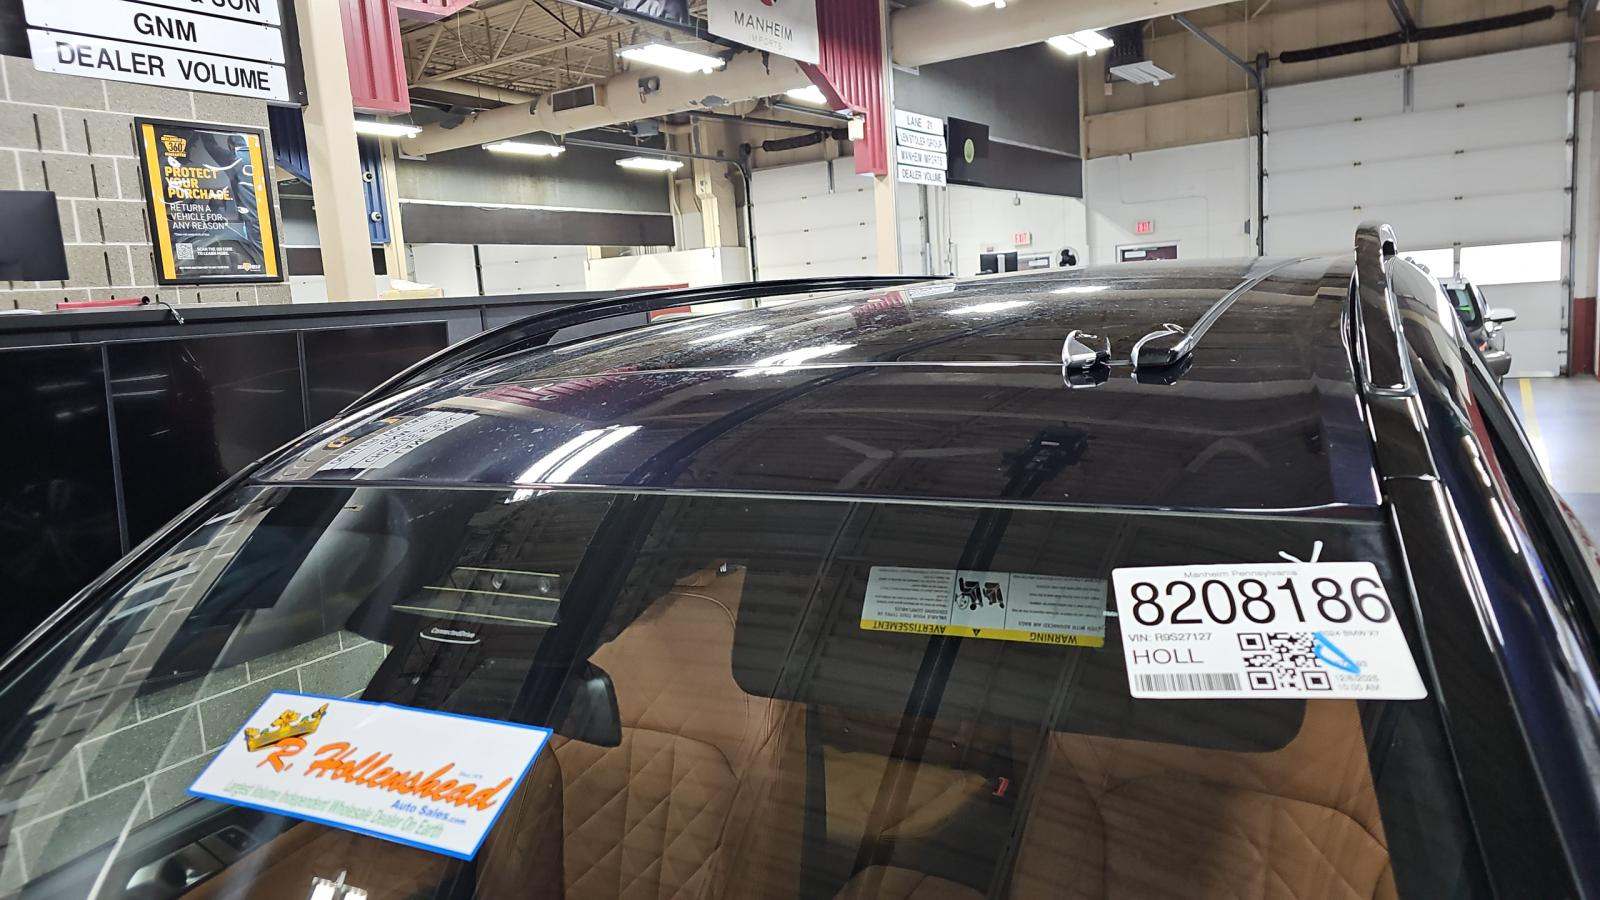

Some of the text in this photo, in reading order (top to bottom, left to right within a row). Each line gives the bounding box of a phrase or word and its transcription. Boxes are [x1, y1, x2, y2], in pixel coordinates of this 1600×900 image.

[133, 12, 197, 42] GNM
[734, 10, 793, 41] MANHEIM
[55, 41, 271, 91] DEALER VOLUME
[907, 115, 922, 128] LANE
[168, 141, 182, 152] 360
[164, 166, 218, 179] PROTECT
[902, 168, 942, 183] DEALER VOLUME
[165, 177, 199, 188] YOUR
[170, 203, 212, 213] RETURN A
[170, 212, 222, 221] VEHICLE FOR
[172, 221, 190, 230] ANY
[1138, 221, 1151, 232] EXIT
[1015, 232, 1027, 244] EXIT
[1131, 577, 1392, 626] 8208186
[873, 620, 946, 635] AVERTISSEMENT
[1029, 631, 1078, 645] WARNING
[1128, 631, 1213, 642] VIN: R9S27127
[1133, 648, 1204, 664] HOLL
[303, 741, 513, 812] Hollenshead
[391, 799, 417, 814] Auto
